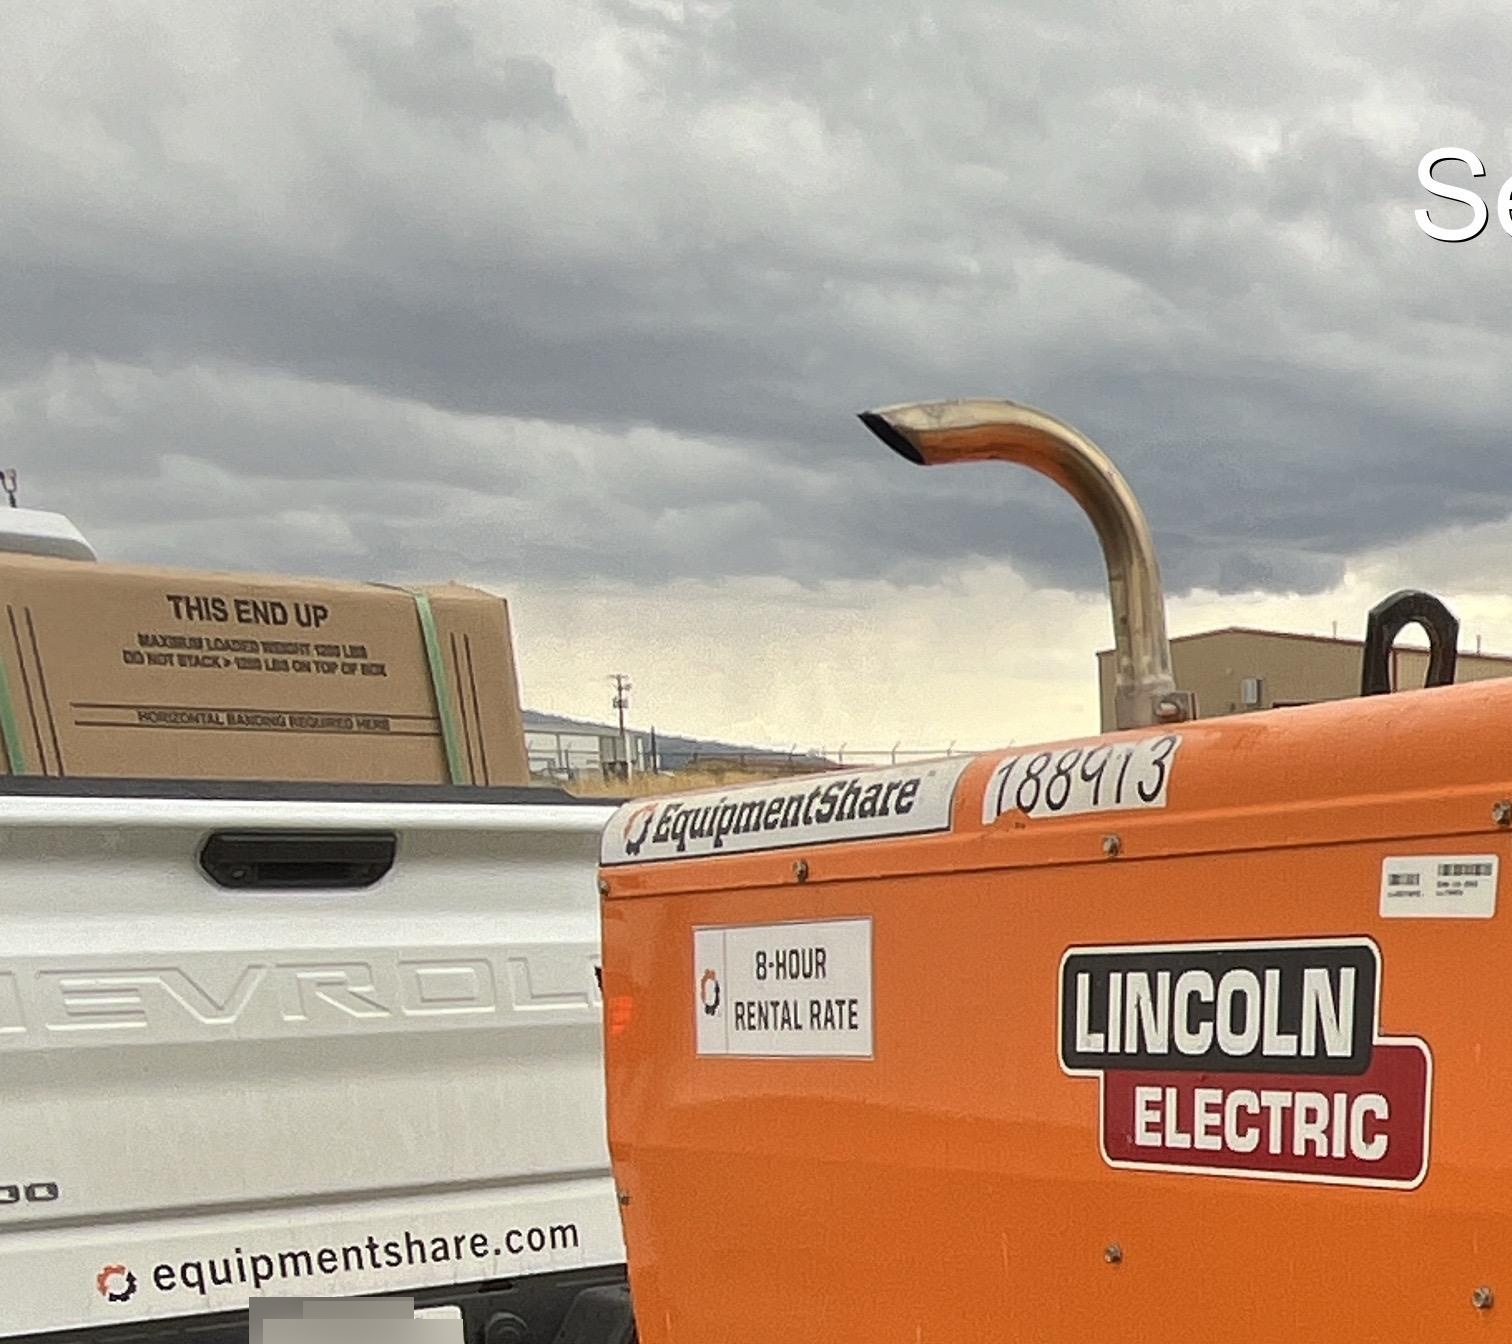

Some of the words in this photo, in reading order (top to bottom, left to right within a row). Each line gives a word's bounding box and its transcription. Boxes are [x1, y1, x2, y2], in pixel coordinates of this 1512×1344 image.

[137, 632, 204, 651] MAXIMUM
[204, 637, 260, 654] LOADED
[166, 594, 229, 623] THIS
[236, 599, 288, 627] END
[295, 602, 329, 628] UP
[147, 651, 176, 667] NOT
[315, 662, 340, 675] TOP
[995, 734, 1181, 817] 188913
[652, 776, 922, 852] EquipmentShare
[0, 955, 603, 1035] EVROL
[754, 946, 828, 981] 8-HOUR
[733, 1000, 803, 1031] RENTAL
[809, 998, 859, 1031] RATE
[1075, 967, 1356, 1058] LINCOLN
[1134, 1085, 1390, 1161] ELECTRIC
[152, 1223, 580, 1296] equipmentshare.com
